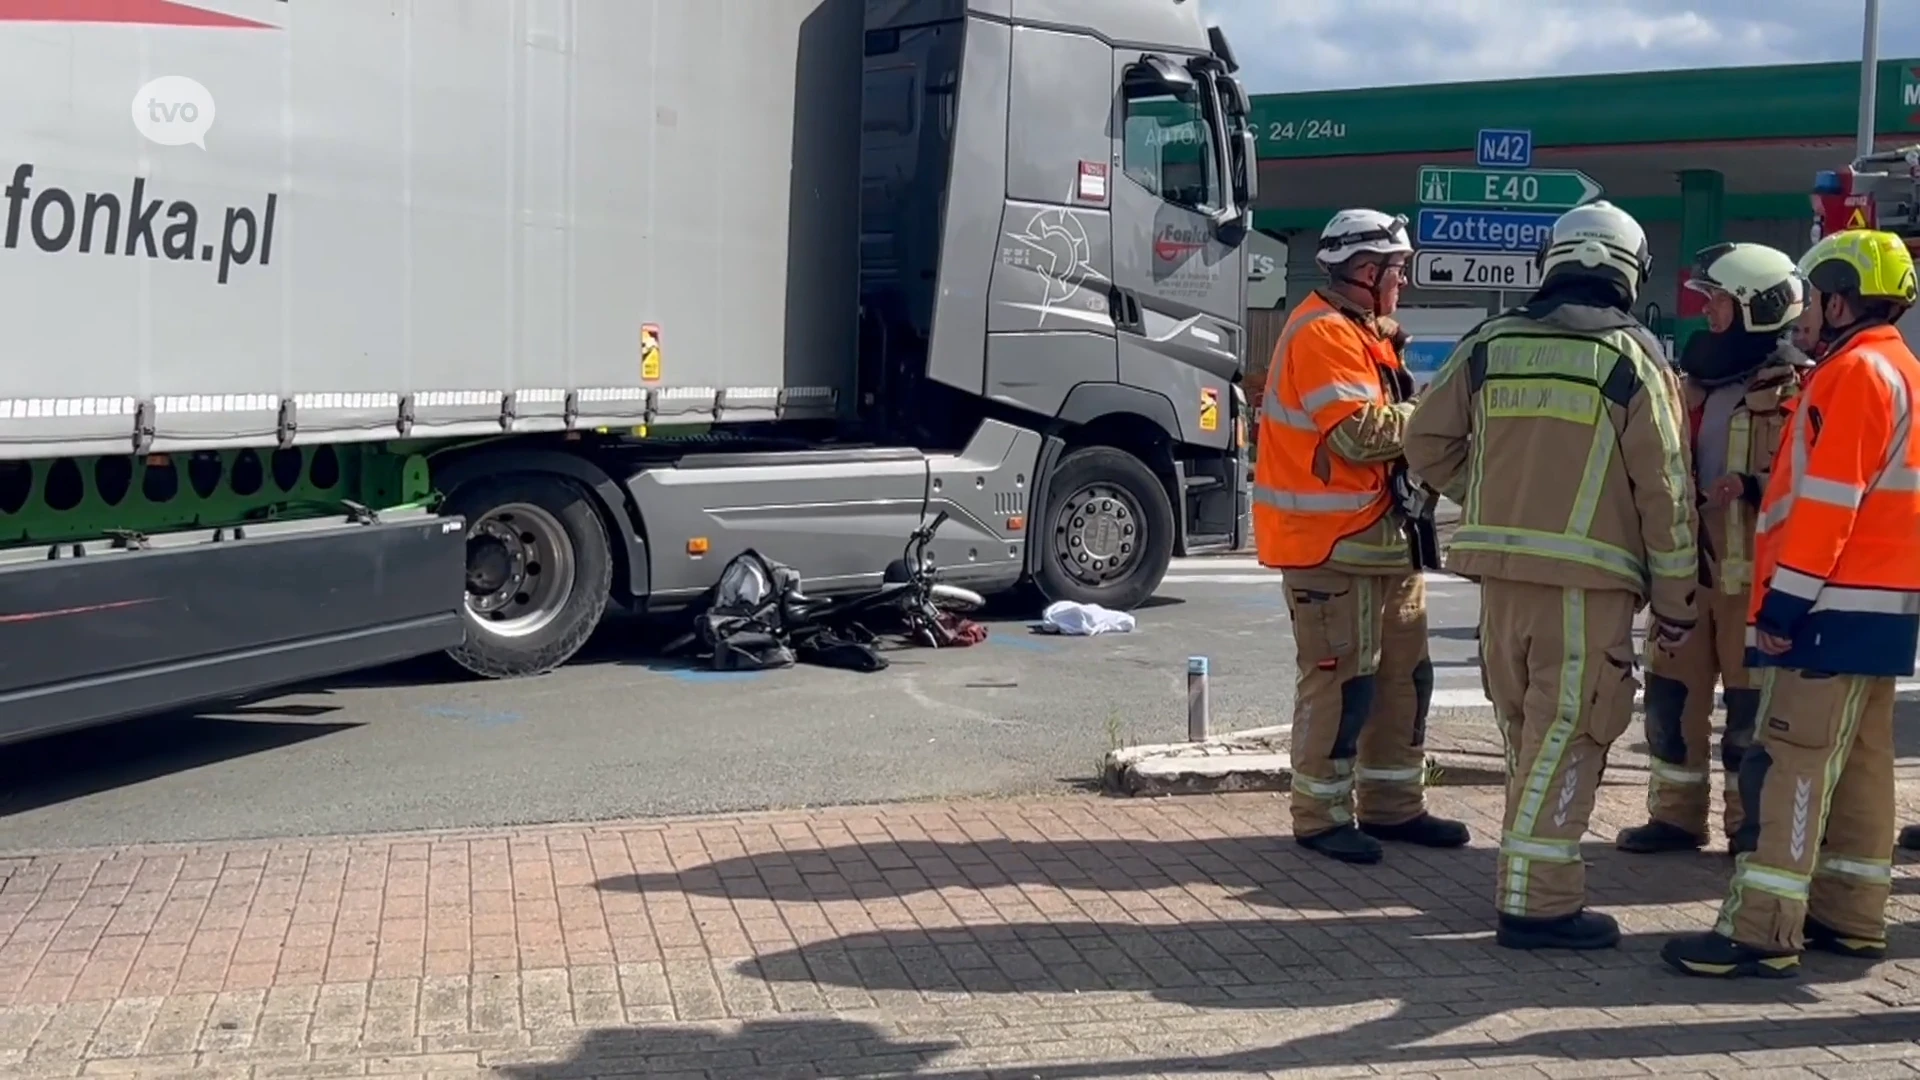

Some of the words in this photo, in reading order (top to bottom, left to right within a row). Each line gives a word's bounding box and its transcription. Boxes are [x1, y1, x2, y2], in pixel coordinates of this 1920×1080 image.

[1269, 118, 1346, 141] 24/24u
[1483, 135, 1525, 161] N42
[1484, 175, 1539, 202] E40
[3, 163, 278, 285] fonka.pl
[1462, 258, 1515, 284] Zone
[1525, 259, 1532, 285] 1
